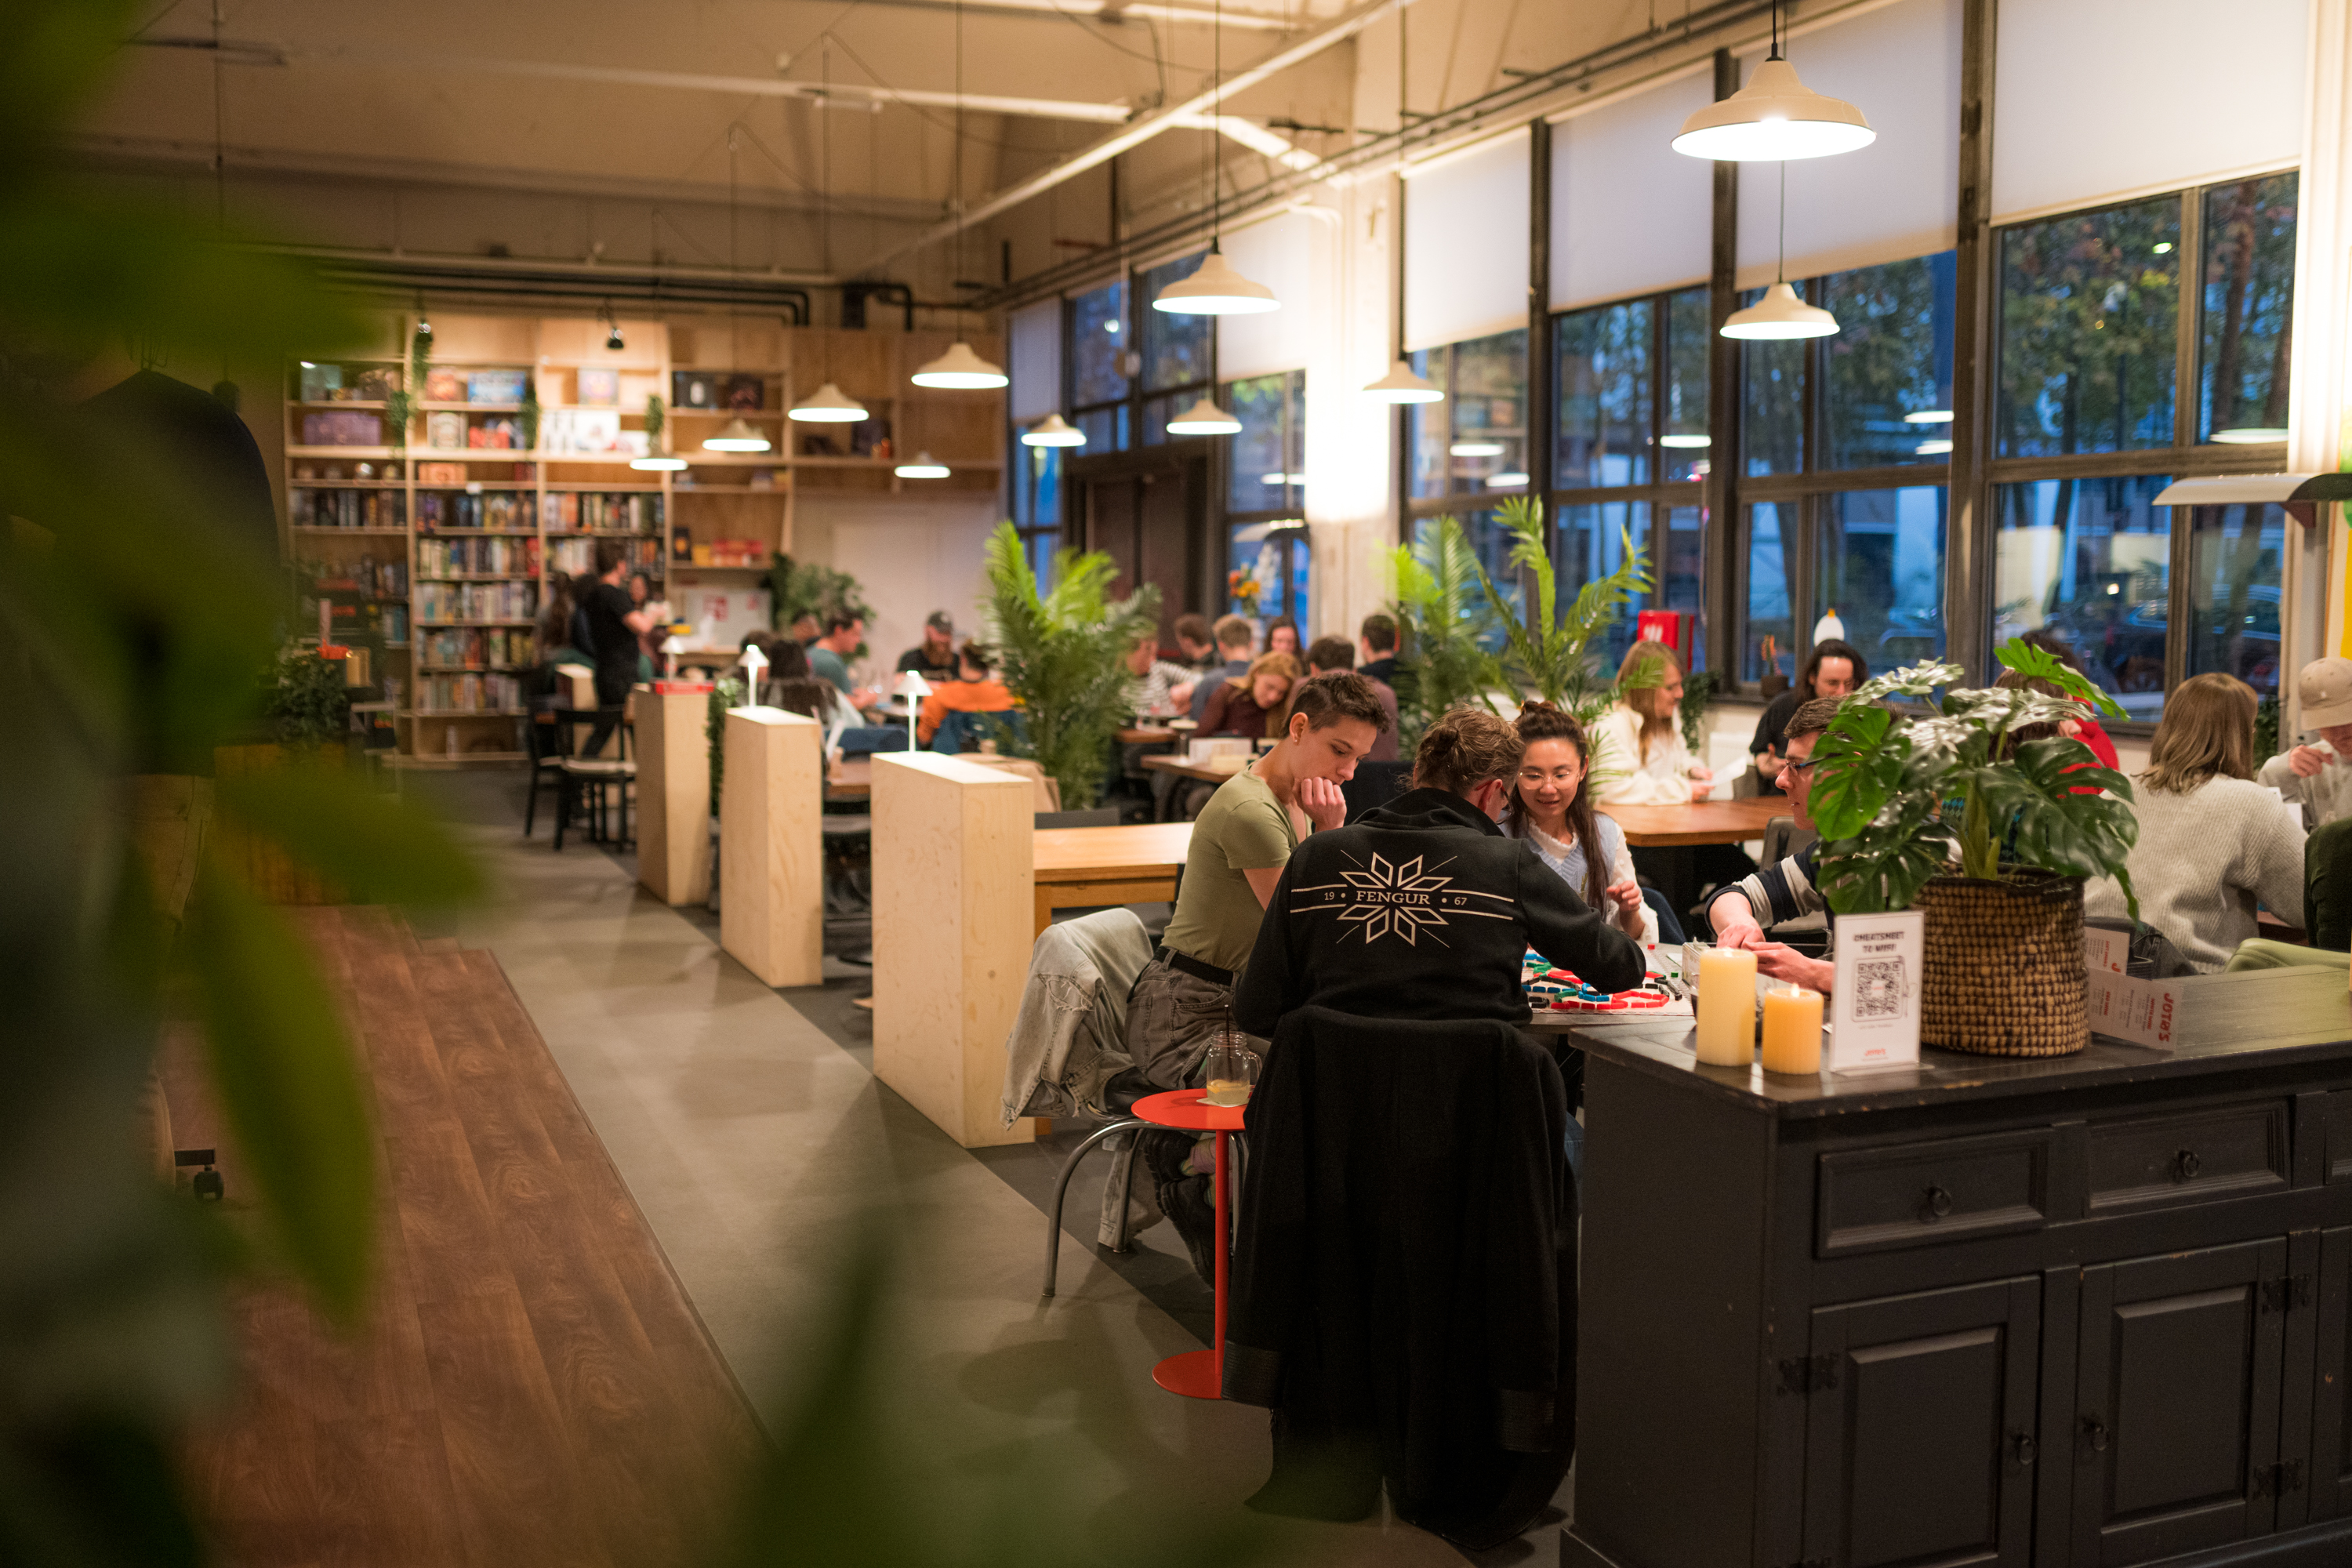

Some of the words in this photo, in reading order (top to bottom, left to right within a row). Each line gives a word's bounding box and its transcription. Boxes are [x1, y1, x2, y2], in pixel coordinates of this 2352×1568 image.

[1323, 891, 1335, 901] 19
[1356, 891, 1431, 905] FENGUR
[1454, 896, 1468, 906] 67
